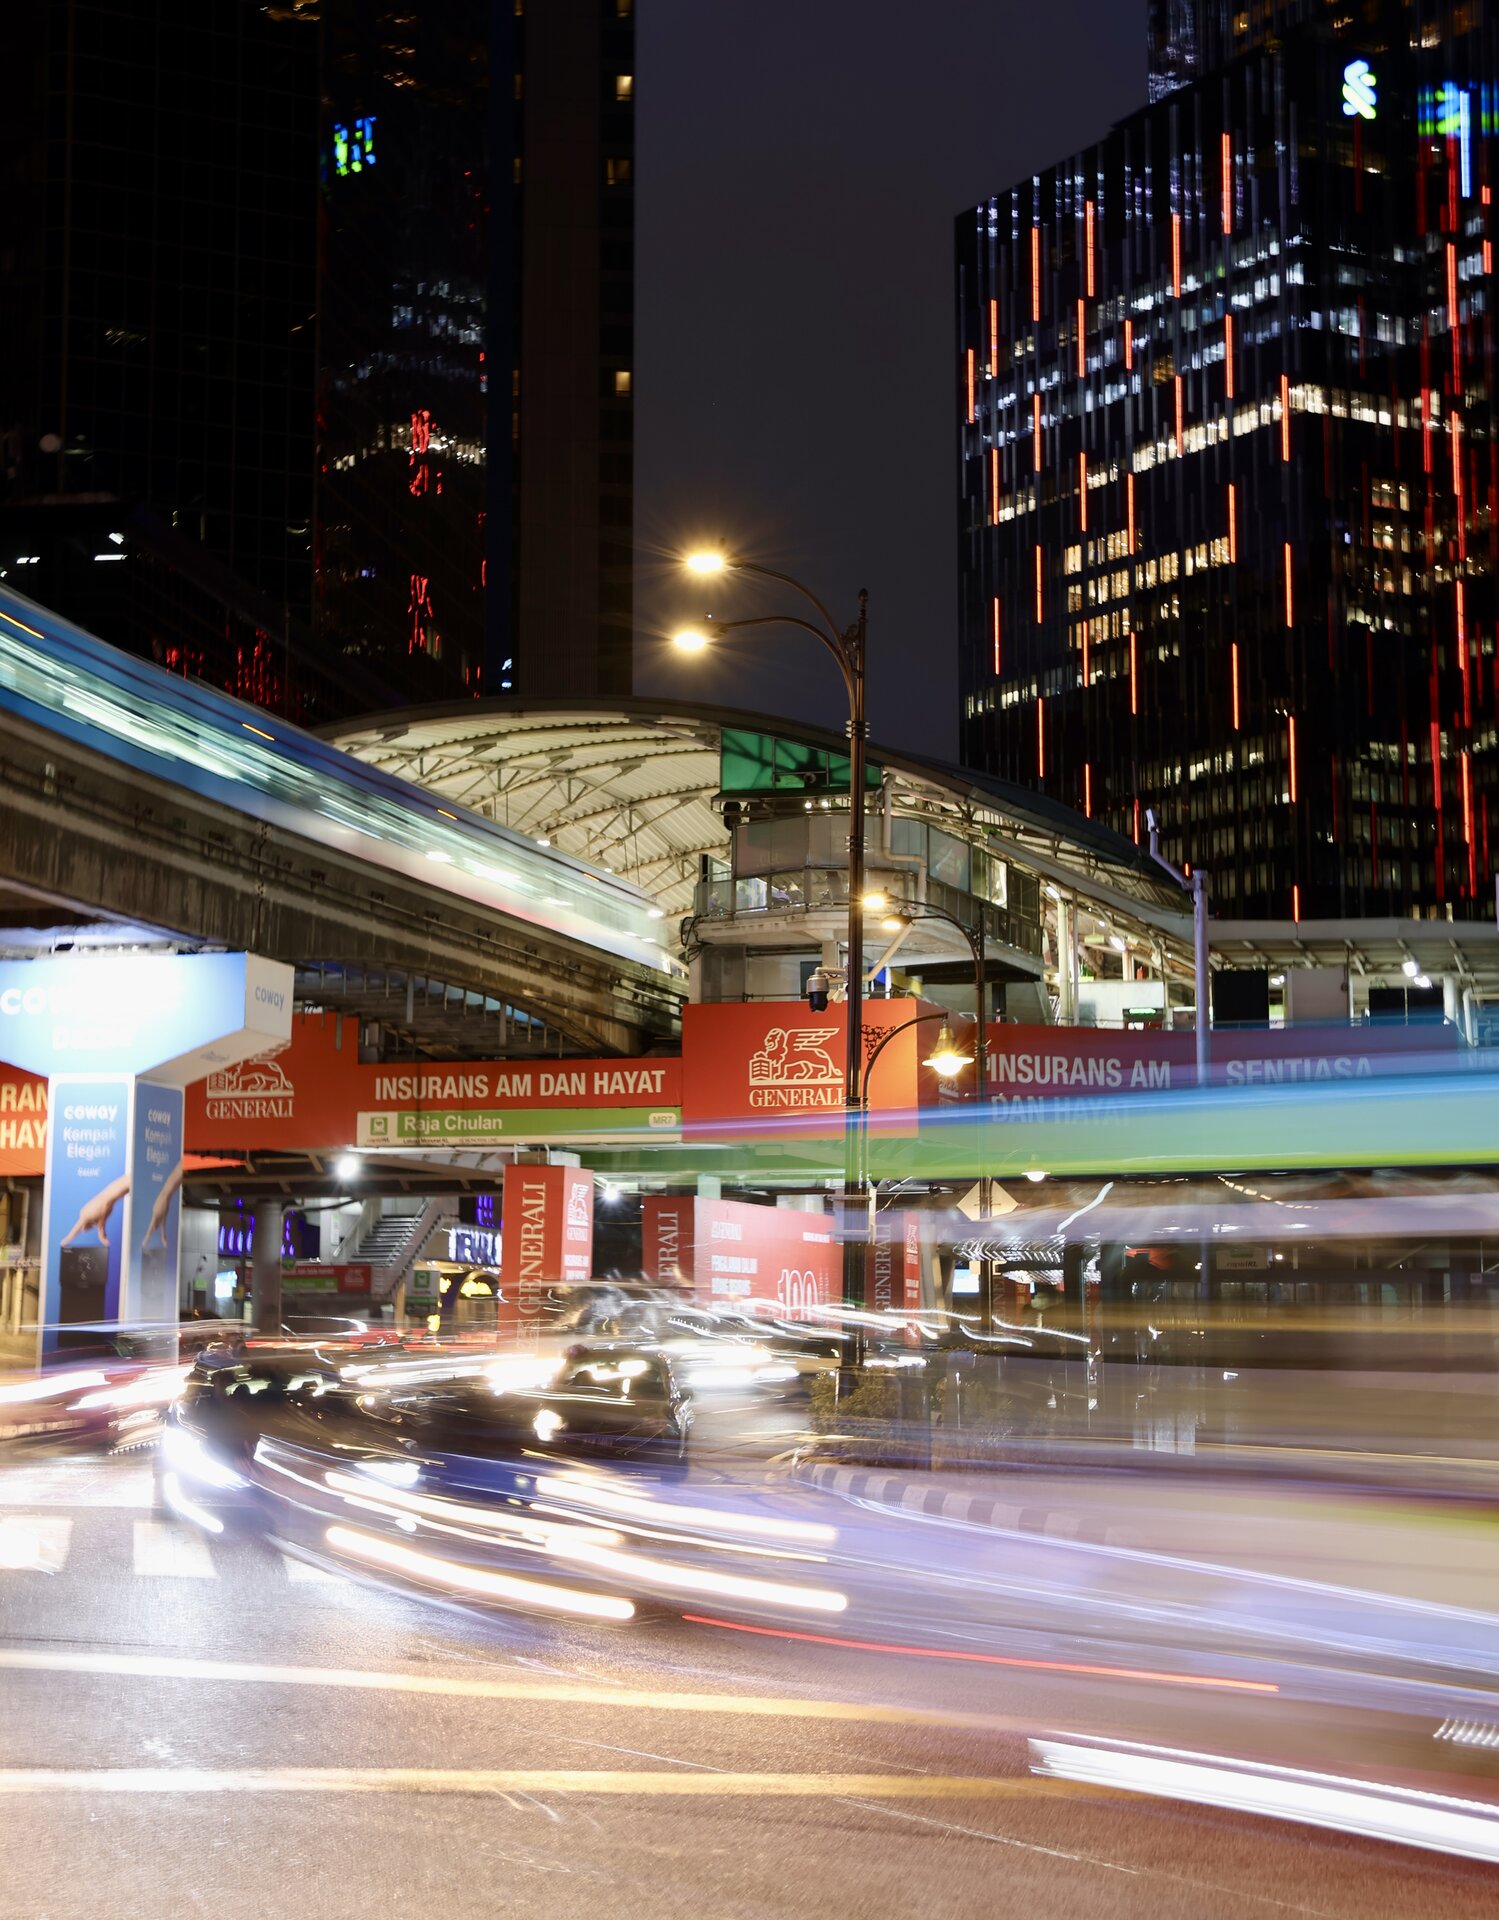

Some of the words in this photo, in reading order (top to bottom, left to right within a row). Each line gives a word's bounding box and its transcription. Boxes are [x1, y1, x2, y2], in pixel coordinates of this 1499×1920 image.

[989, 1053, 1122, 1088] INSURANS
[1130, 1059, 1171, 1089] AM
[1226, 1056, 1373, 1085] SENTIASA
[375, 1074, 489, 1101] INSURANS
[495, 1073, 532, 1098] AM
[539, 1072, 586, 1097] DAN
[593, 1070, 666, 1095] HAYAT
[748, 1087, 846, 1108] GENERALI
[205, 1098, 294, 1120] GENERALI
[652, 1114, 673, 1125] MR7
[991, 1095, 1045, 1124] DAN
[63, 1126, 117, 1145] Kompak
[404, 1115, 440, 1135] Raja
[444, 1114, 503, 1131] Chulan
[66, 1144, 111, 1162] Elegan
[518, 1181, 546, 1315] GENERALI
